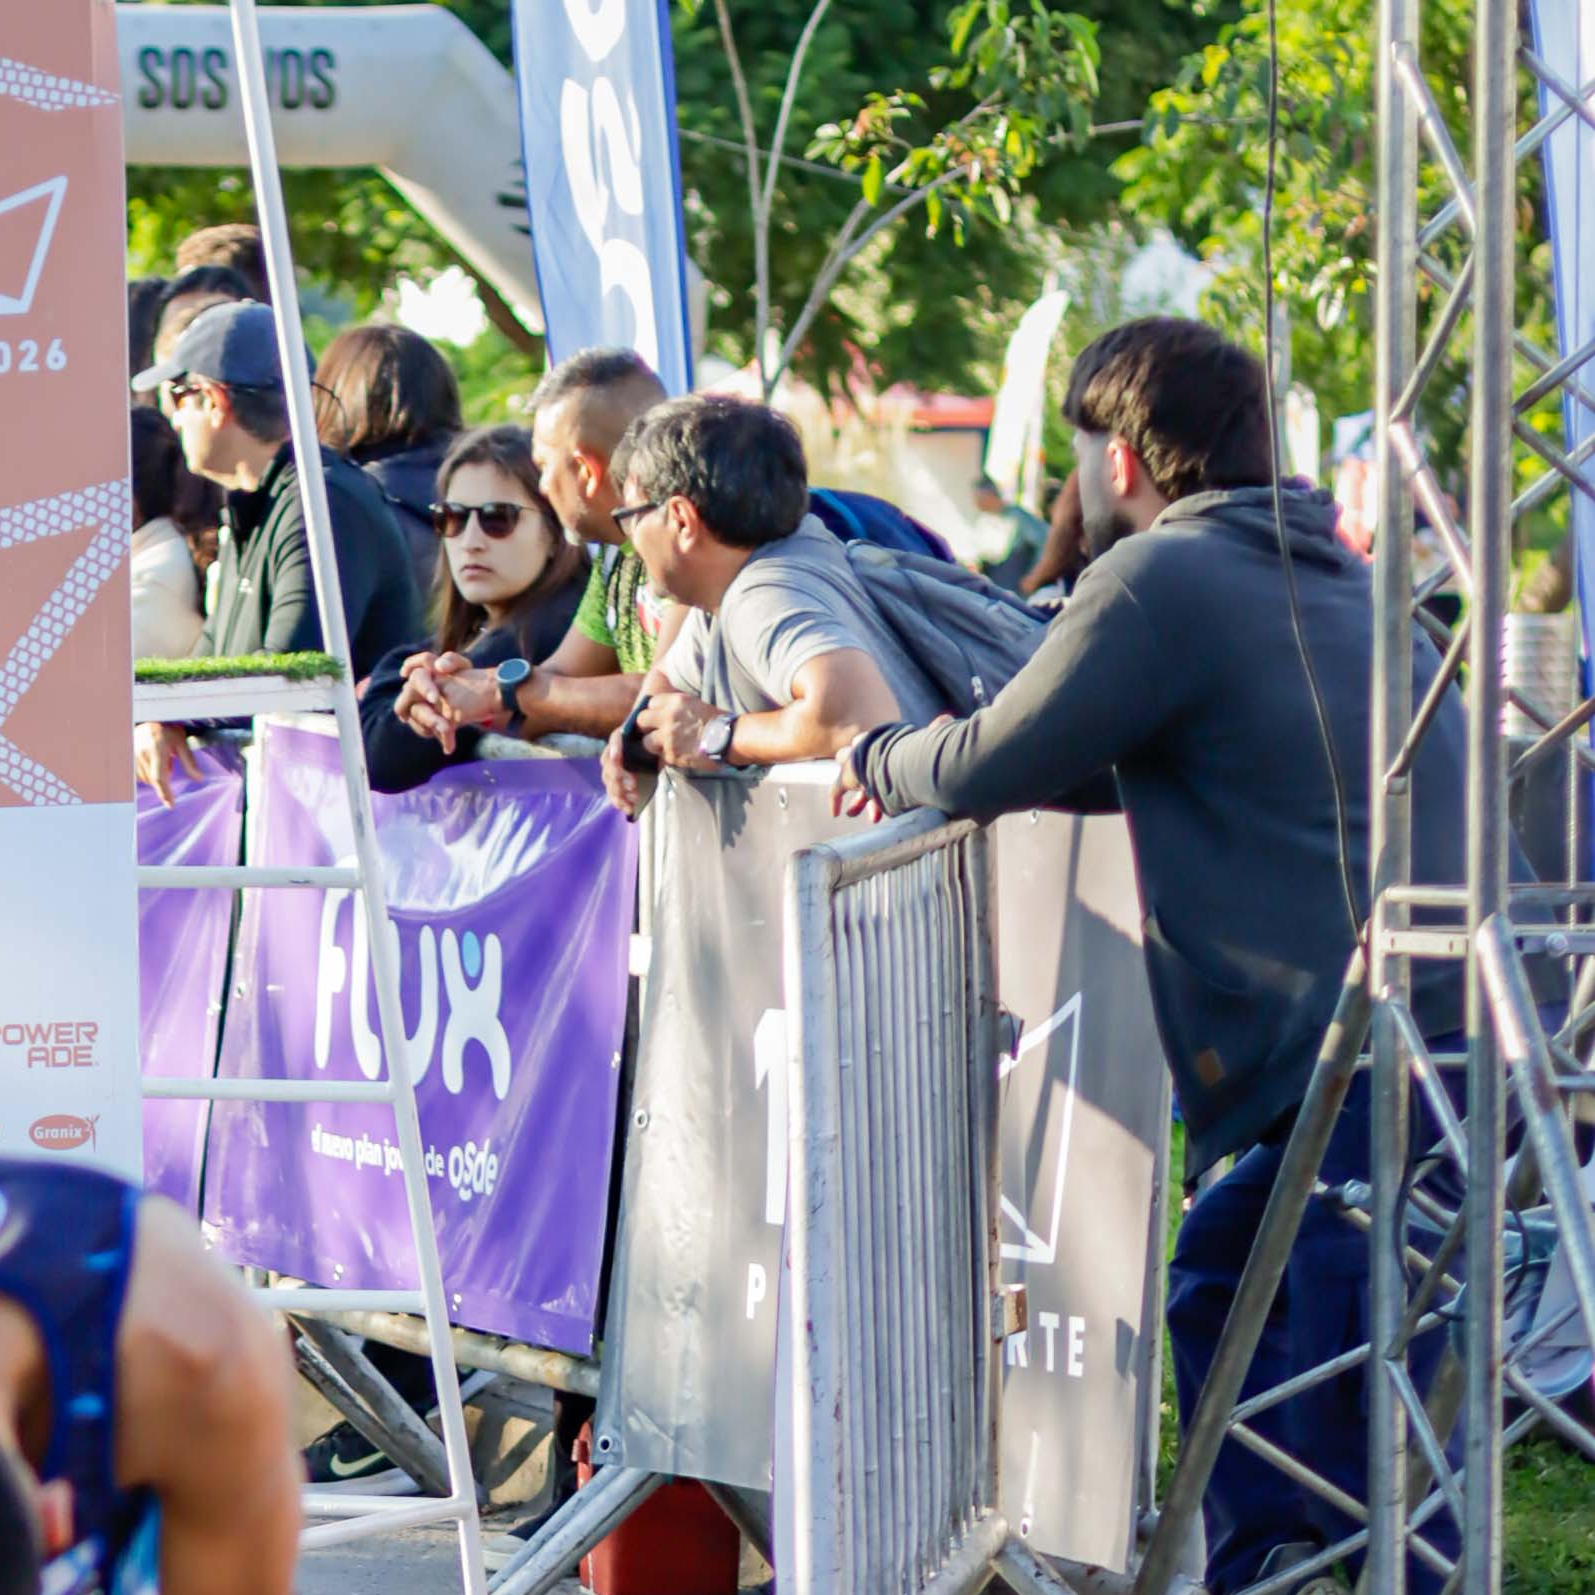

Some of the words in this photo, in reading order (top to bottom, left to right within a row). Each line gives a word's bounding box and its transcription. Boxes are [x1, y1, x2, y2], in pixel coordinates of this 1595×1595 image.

[138, 46, 229, 110] SOS
[33, 1124, 83, 1140] Granix
[355, 1133, 382, 1170] plan
[425, 1145, 445, 1177] de
[447, 1138, 499, 1196] osde
